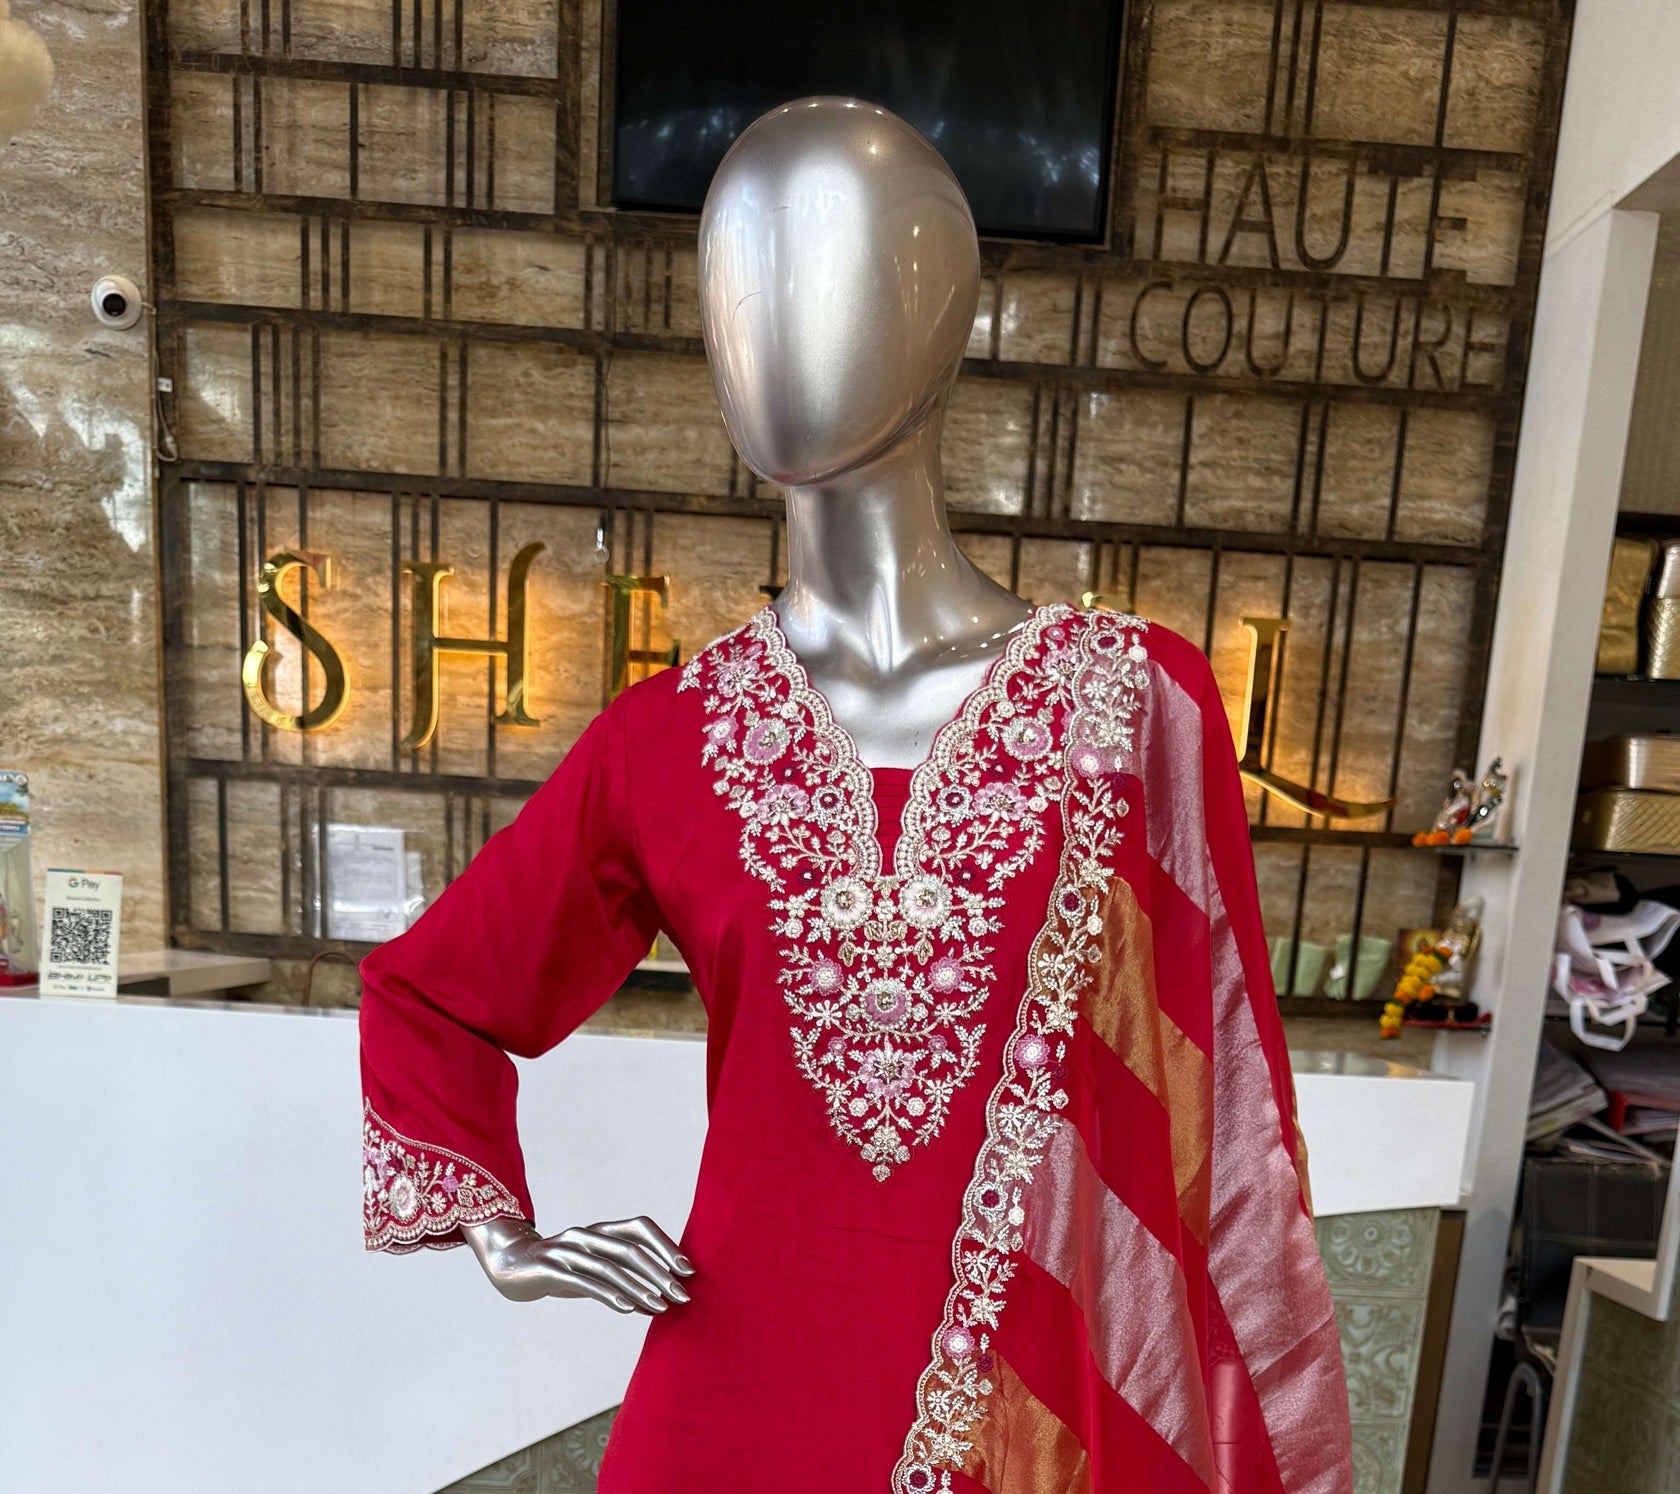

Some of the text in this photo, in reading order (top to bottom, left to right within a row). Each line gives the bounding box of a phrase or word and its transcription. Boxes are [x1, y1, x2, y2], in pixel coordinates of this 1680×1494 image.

[1153, 148, 1477, 280] HAUTE
[1130, 280, 1498, 392] COUTURE
[241, 540, 1397, 820] SHEL
[81, 878, 101, 892] Pay
